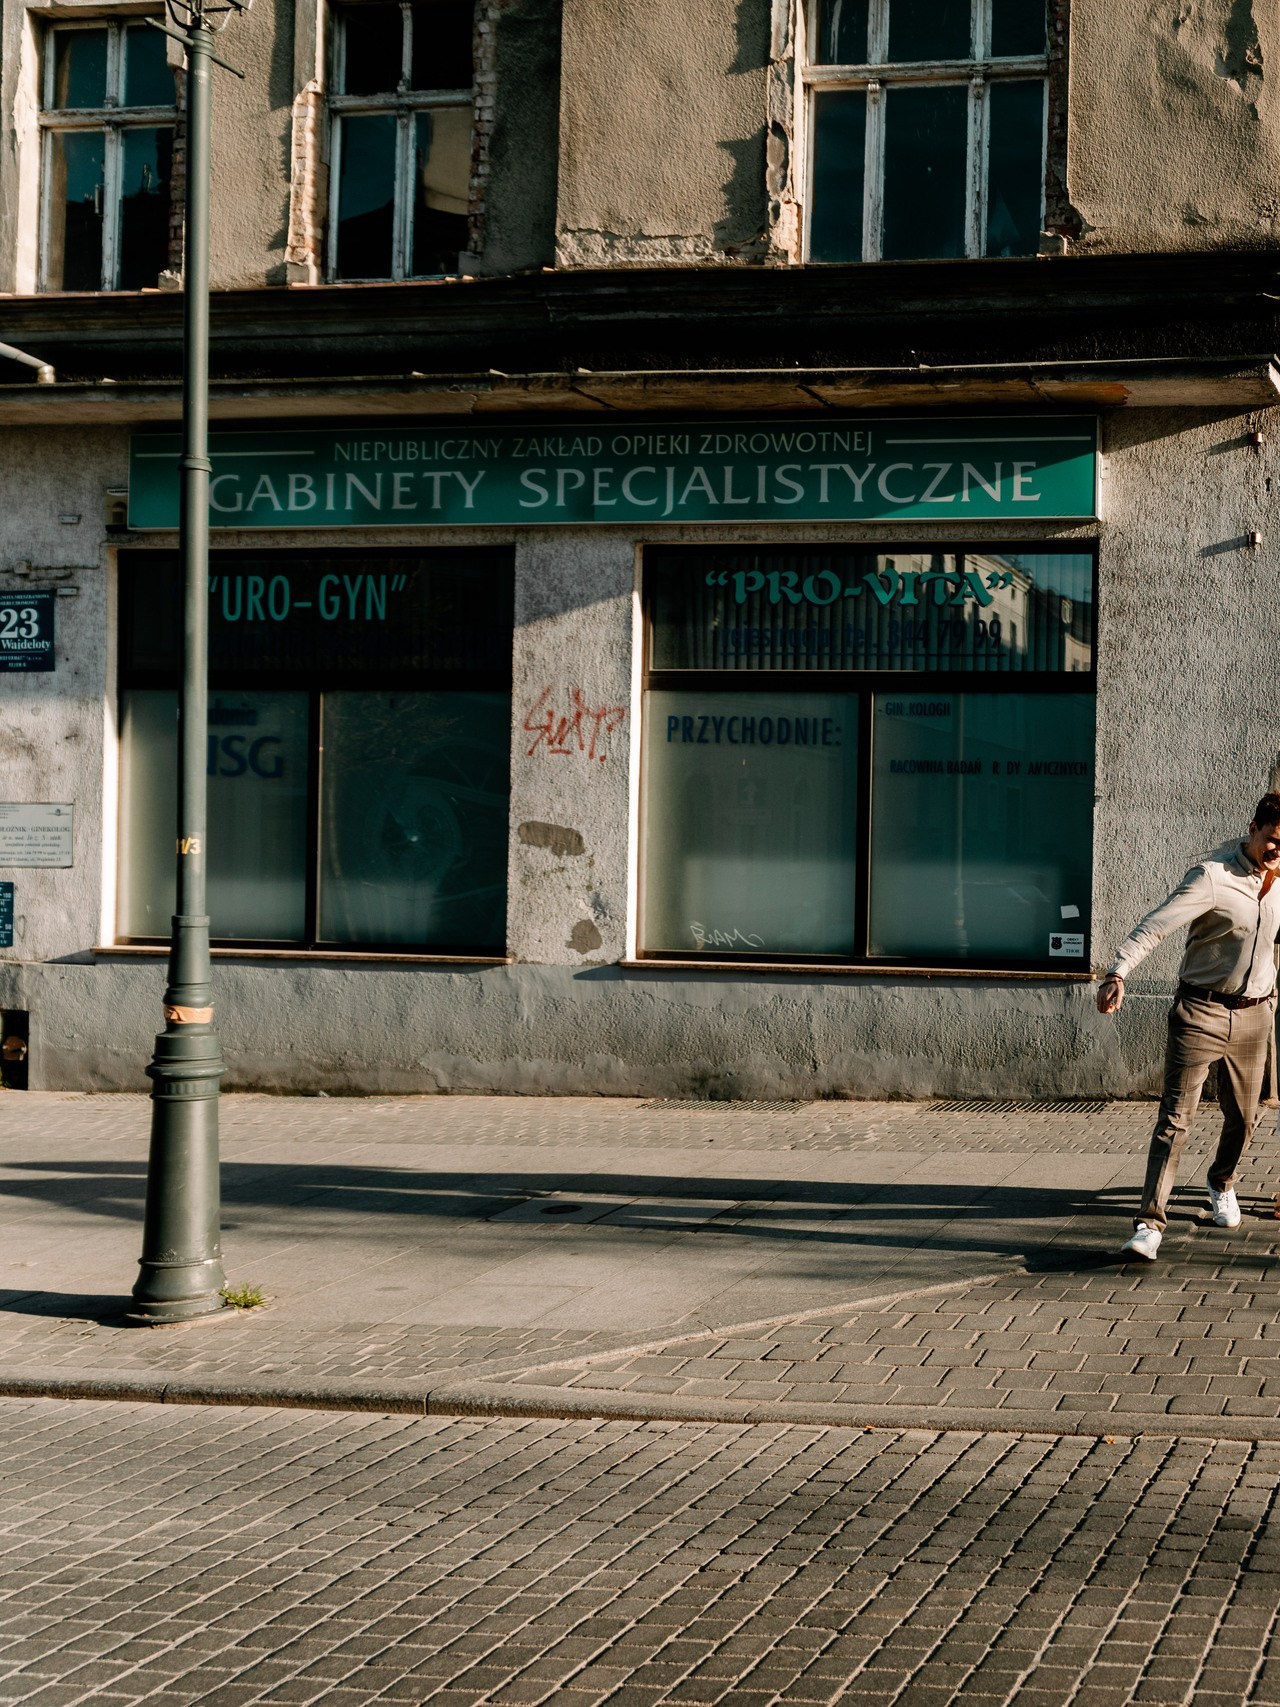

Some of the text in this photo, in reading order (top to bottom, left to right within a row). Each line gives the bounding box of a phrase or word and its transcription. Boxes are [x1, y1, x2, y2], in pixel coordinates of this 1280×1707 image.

[334, 431, 872, 461] NIEPUBLICZNY ZAKŁAD OPIEKI ZDROWOTNEJ
[208, 461, 1041, 517] GABINETY SPECJALISTYCZNE
[705, 568, 1013, 606] "PRO-VITA"
[0, 607, 38, 638] 23
[887, 618, 930, 648] 344
[938, 619, 967, 648] 79
[975, 618, 1003, 648] 99
[667, 715, 841, 746] PRZYCHODNIE:
